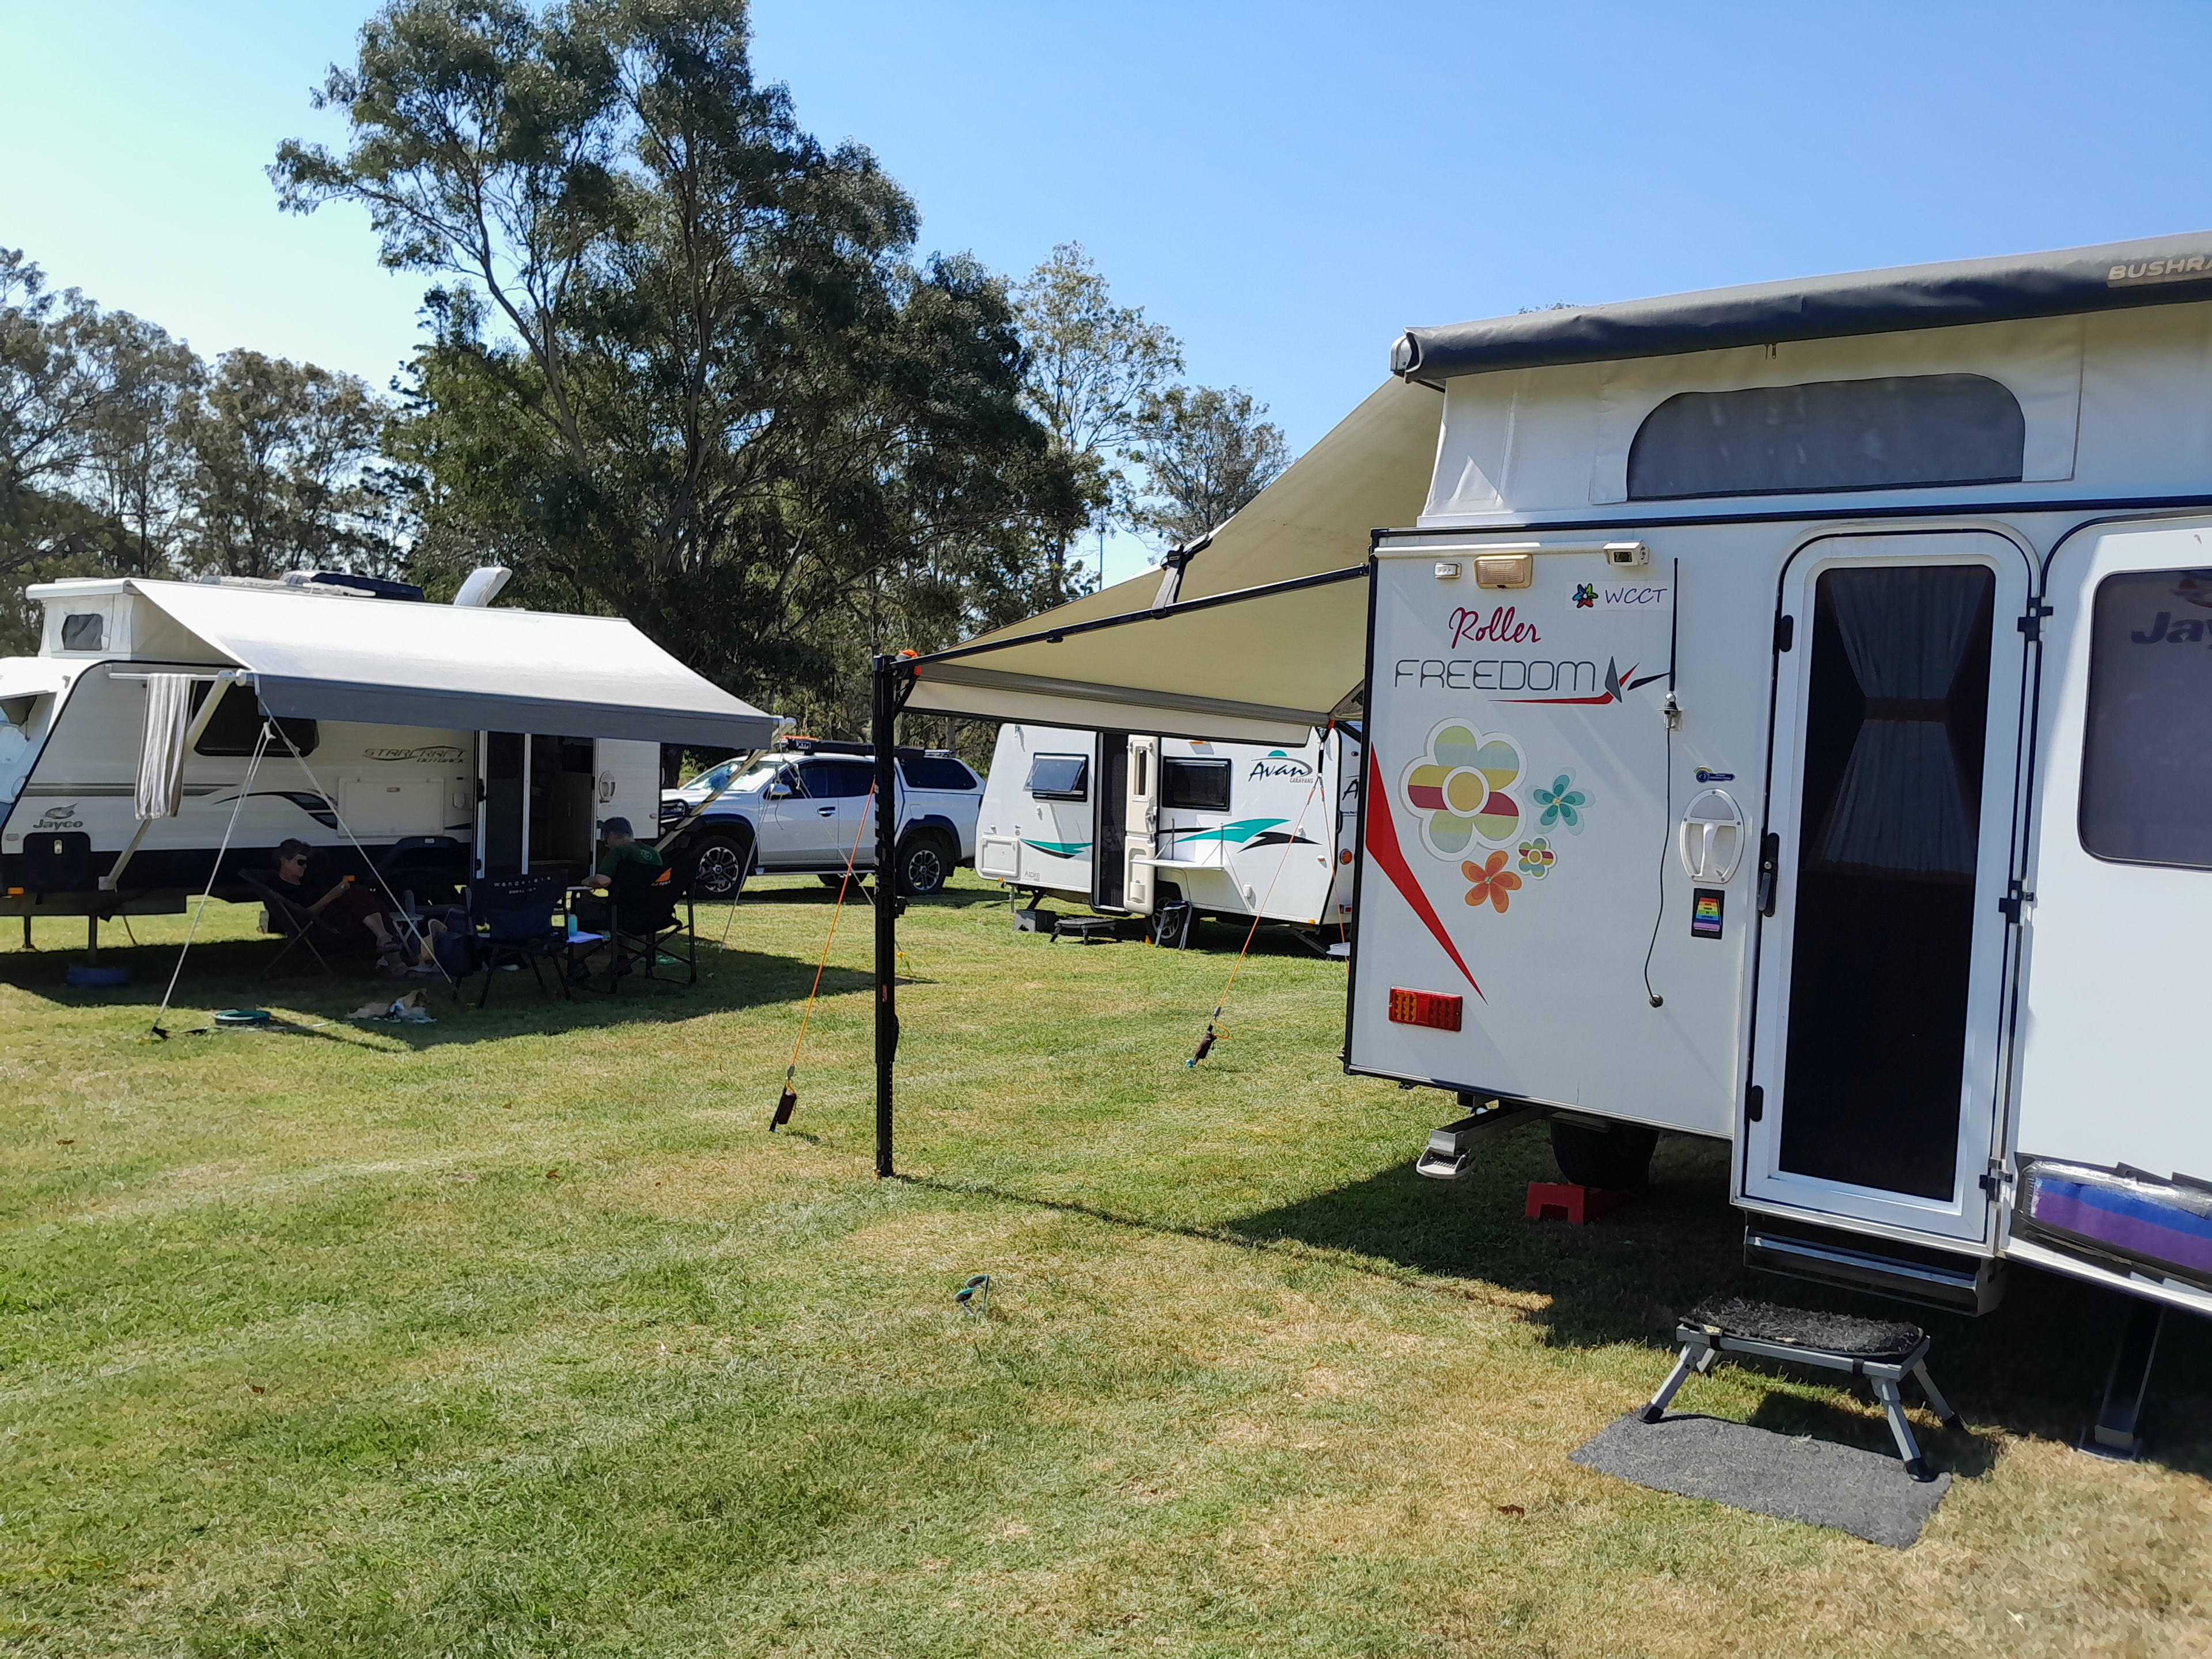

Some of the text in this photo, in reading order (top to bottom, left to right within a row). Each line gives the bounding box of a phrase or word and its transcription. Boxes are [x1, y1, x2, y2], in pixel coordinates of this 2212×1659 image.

[1605, 587, 1668, 604] WCCT
[1449, 607, 1541, 649] Roller
[1395, 660, 1596, 691] FREEDOM
[1247, 761, 1307, 782] Avan
[32, 819, 83, 831] Jayco
